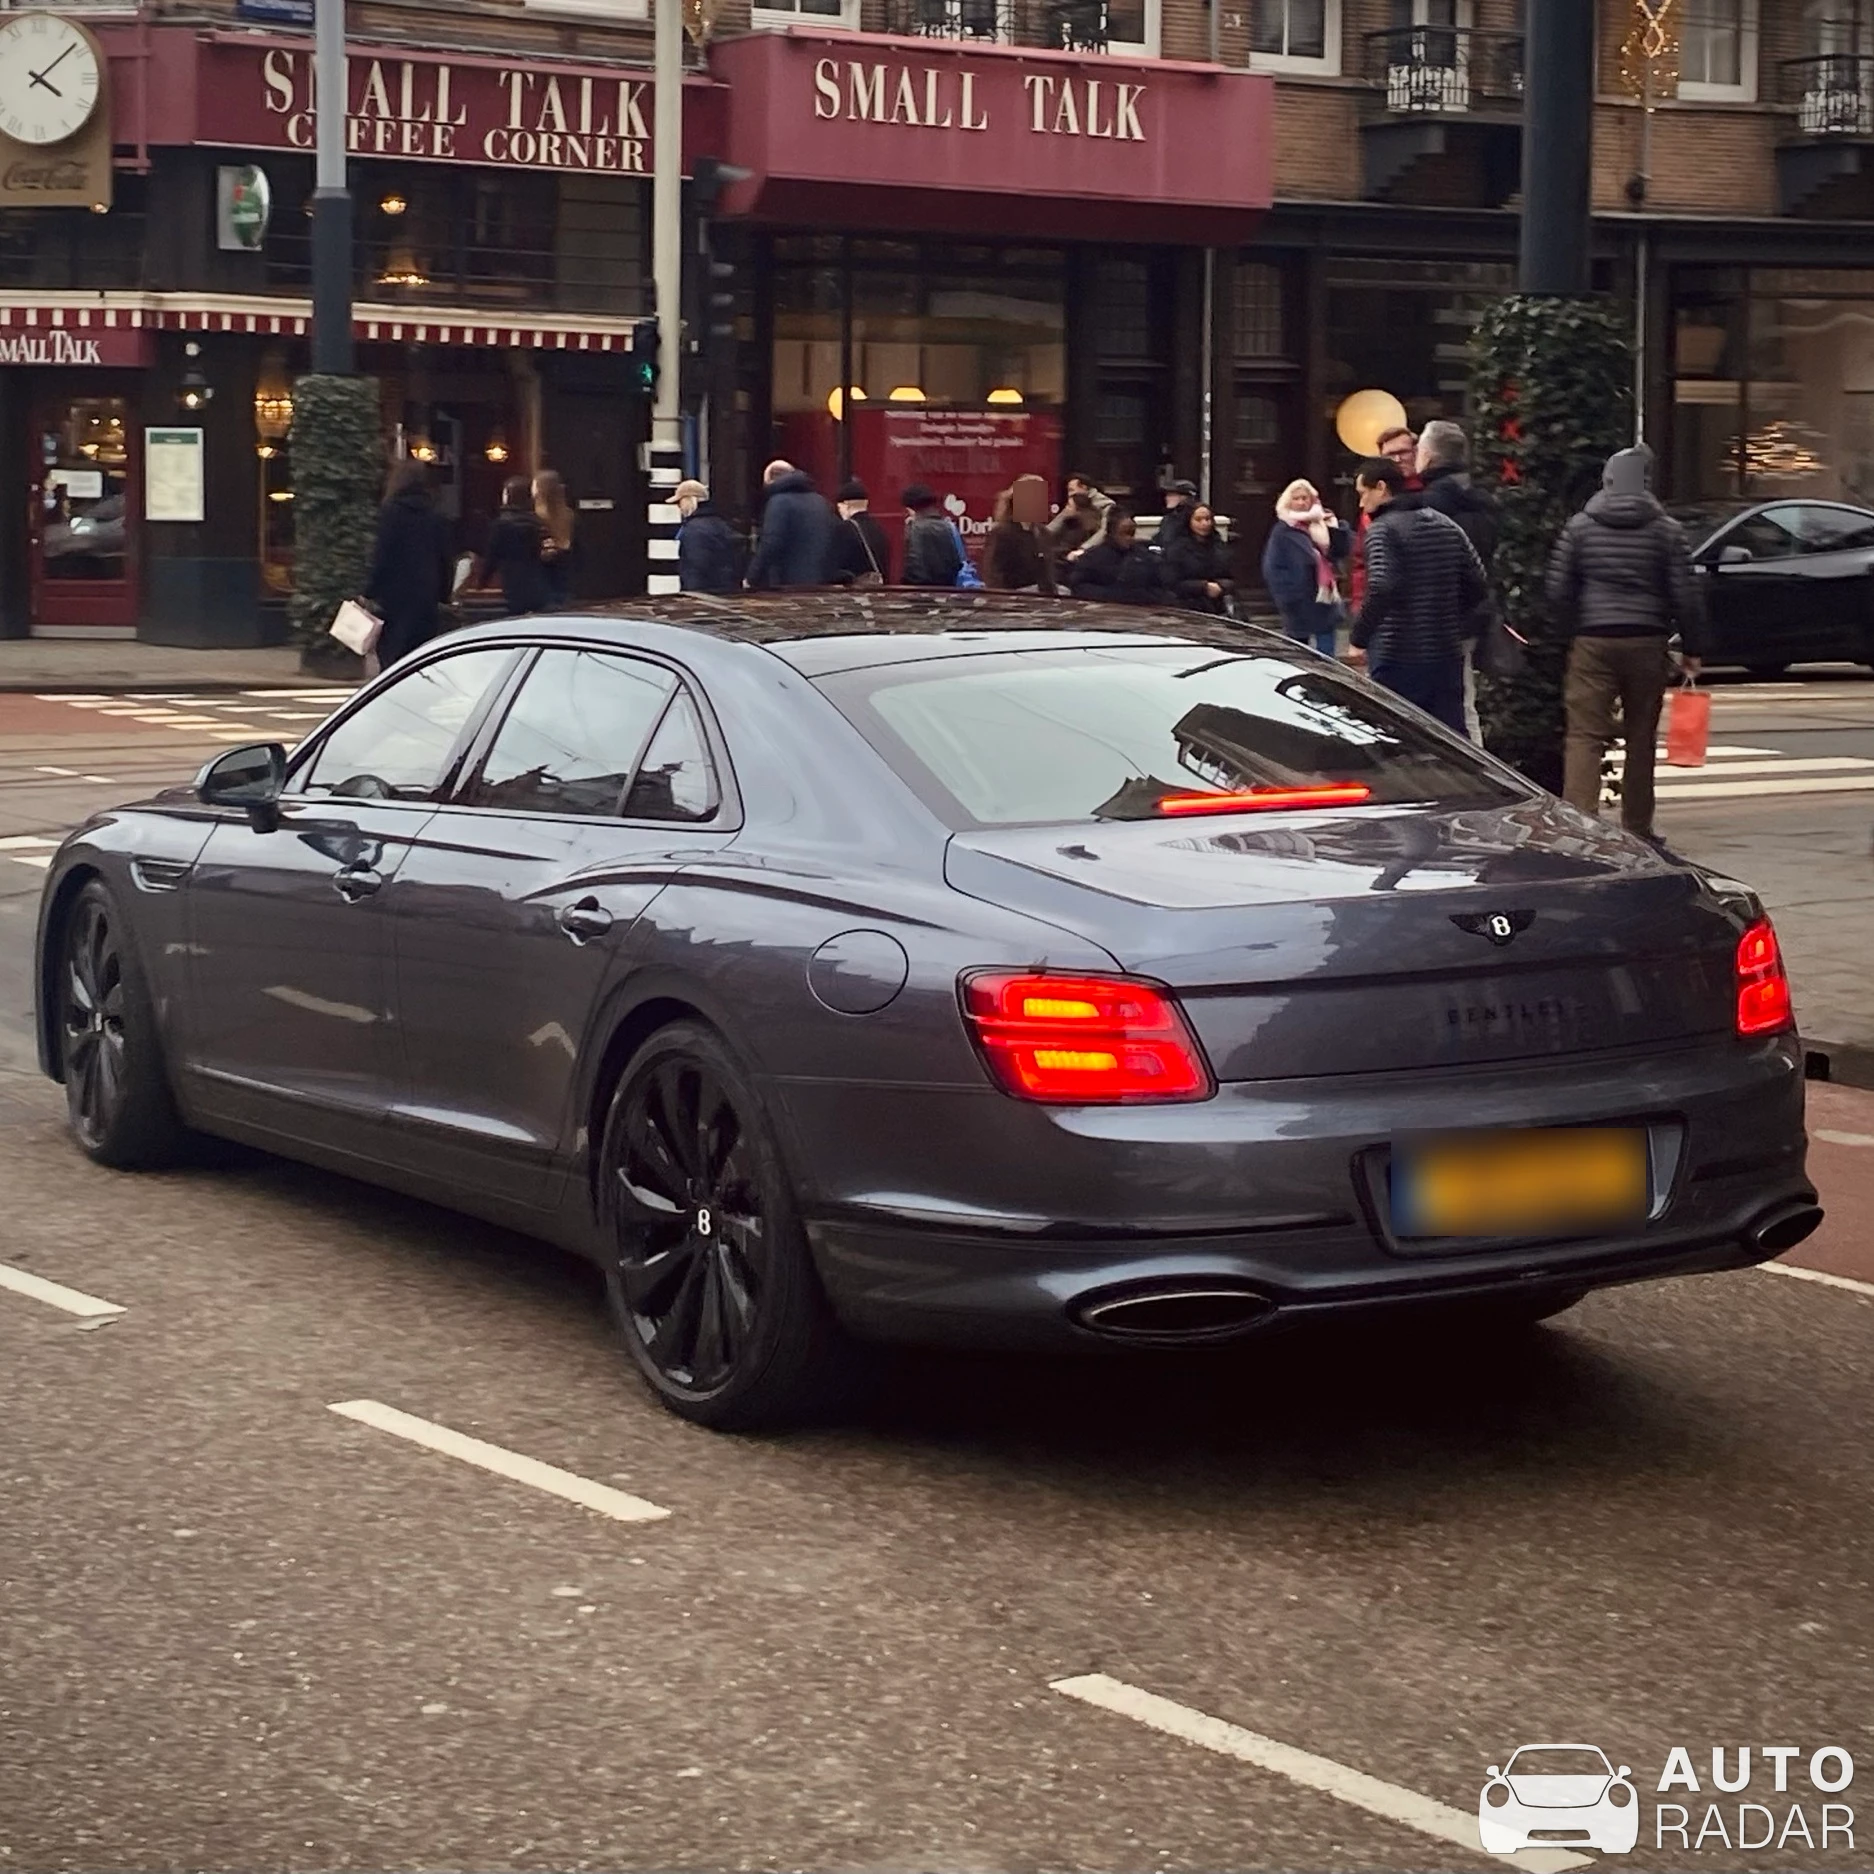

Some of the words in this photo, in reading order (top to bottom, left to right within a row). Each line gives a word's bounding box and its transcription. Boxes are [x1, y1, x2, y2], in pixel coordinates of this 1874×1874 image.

[499, 71, 650, 139] TALK
[815, 58, 988, 130] SMALL
[1024, 75, 1147, 141] TALK
[287, 113, 455, 157] CFFEE
[484, 129, 644, 171] CORNER
[0, 333, 52, 363] MALL
